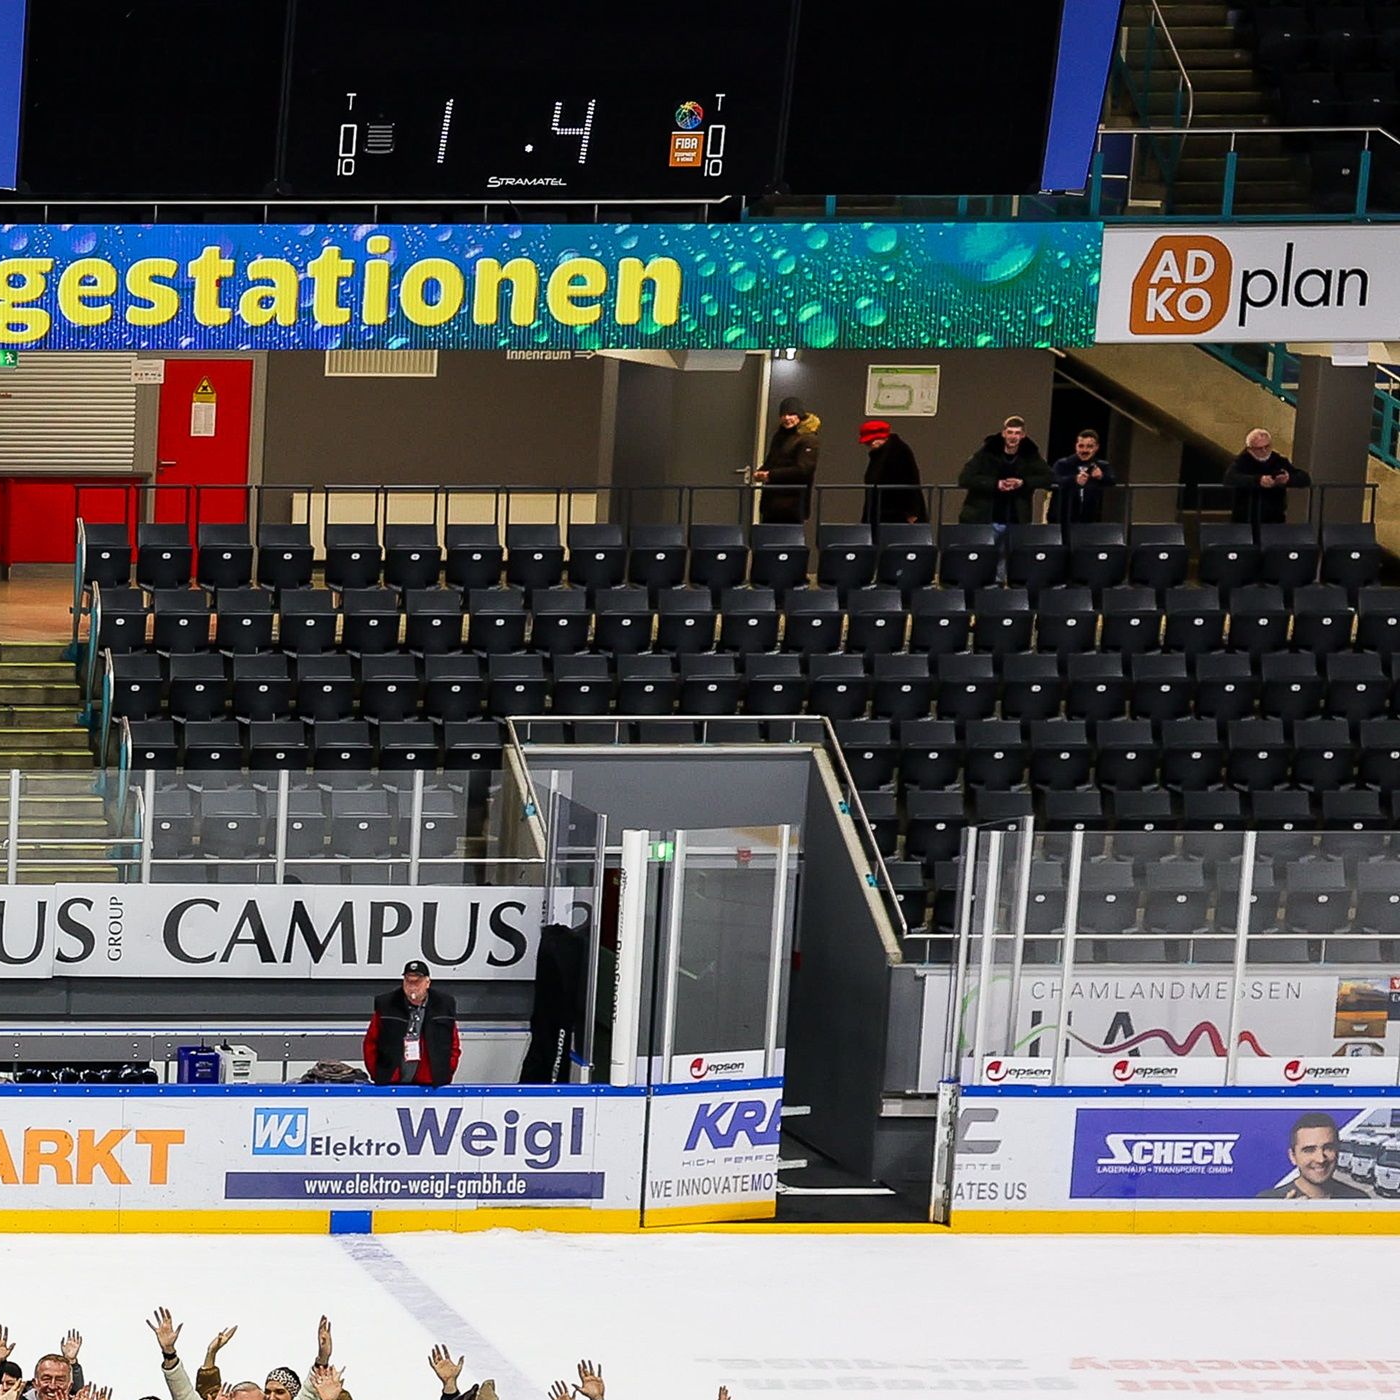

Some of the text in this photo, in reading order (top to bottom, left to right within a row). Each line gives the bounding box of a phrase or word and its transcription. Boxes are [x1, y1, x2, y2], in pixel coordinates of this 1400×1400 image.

[675, 137, 698, 149] FIBA
[487, 175, 567, 188] STRAMATEL
[1148, 249, 1216, 285] AD
[1238, 241, 1369, 327] plan
[1145, 287, 1213, 322] KO
[106, 895, 124, 962] GROUP
[162, 898, 528, 967] CAMPUS
[310, 1107, 585, 1169] Elektro Weigl
[1097, 1132, 1240, 1165] SCHECK
[304, 1174, 527, 1198] www.elektro-weigl-gmbh.de
[651, 1178, 672, 1199] WE
[1005, 1182, 1028, 1200] US
